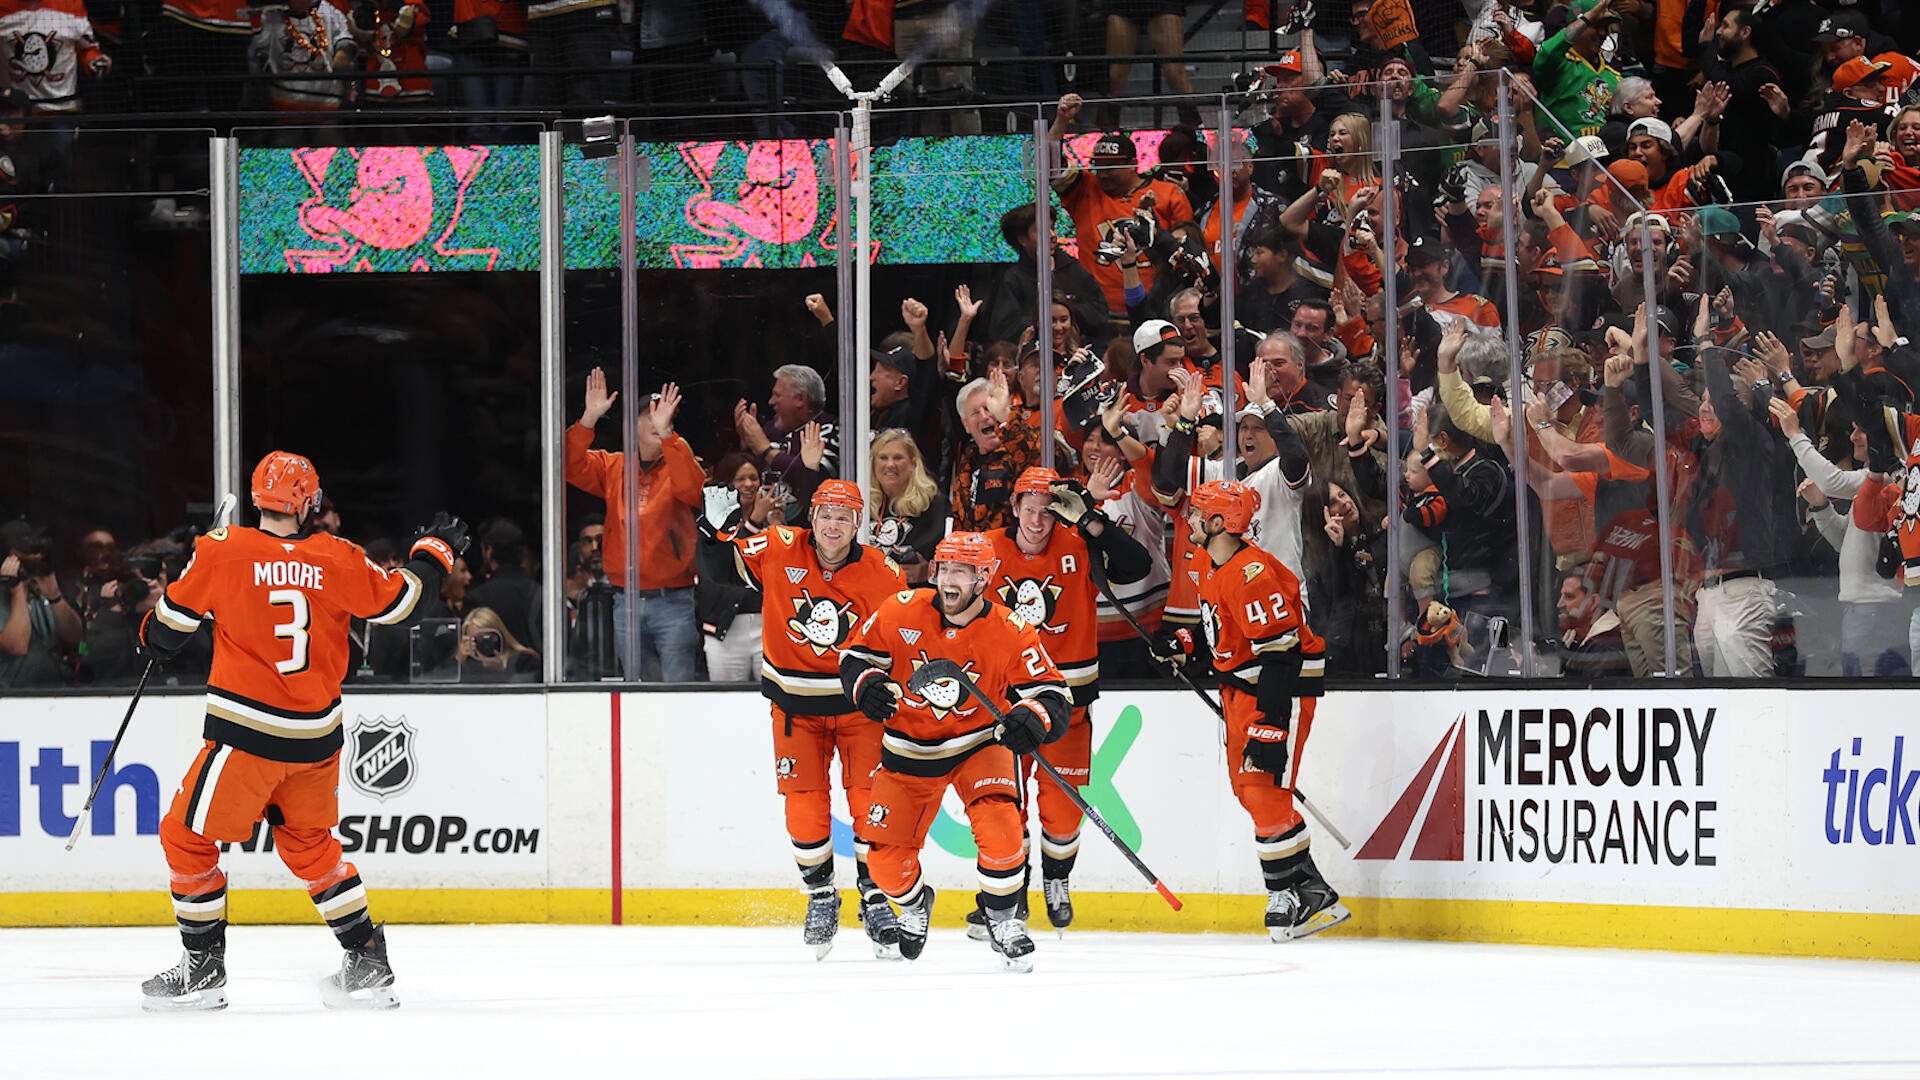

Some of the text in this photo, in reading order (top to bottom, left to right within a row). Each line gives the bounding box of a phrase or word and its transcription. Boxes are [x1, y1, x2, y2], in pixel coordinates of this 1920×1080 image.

[1096, 141, 1120, 155] UCKS
[267, 478, 274, 490] 3
[253, 561, 324, 590] MOORE
[1061, 554, 1077, 574] A
[1245, 592, 1290, 626] 42
[268, 588, 312, 676] 3
[361, 737, 404, 782] NHL
[1478, 707, 1717, 787] MERCURY
[1822, 735, 1920, 846] tick
[1477, 798, 1717, 866] INSURANCE
